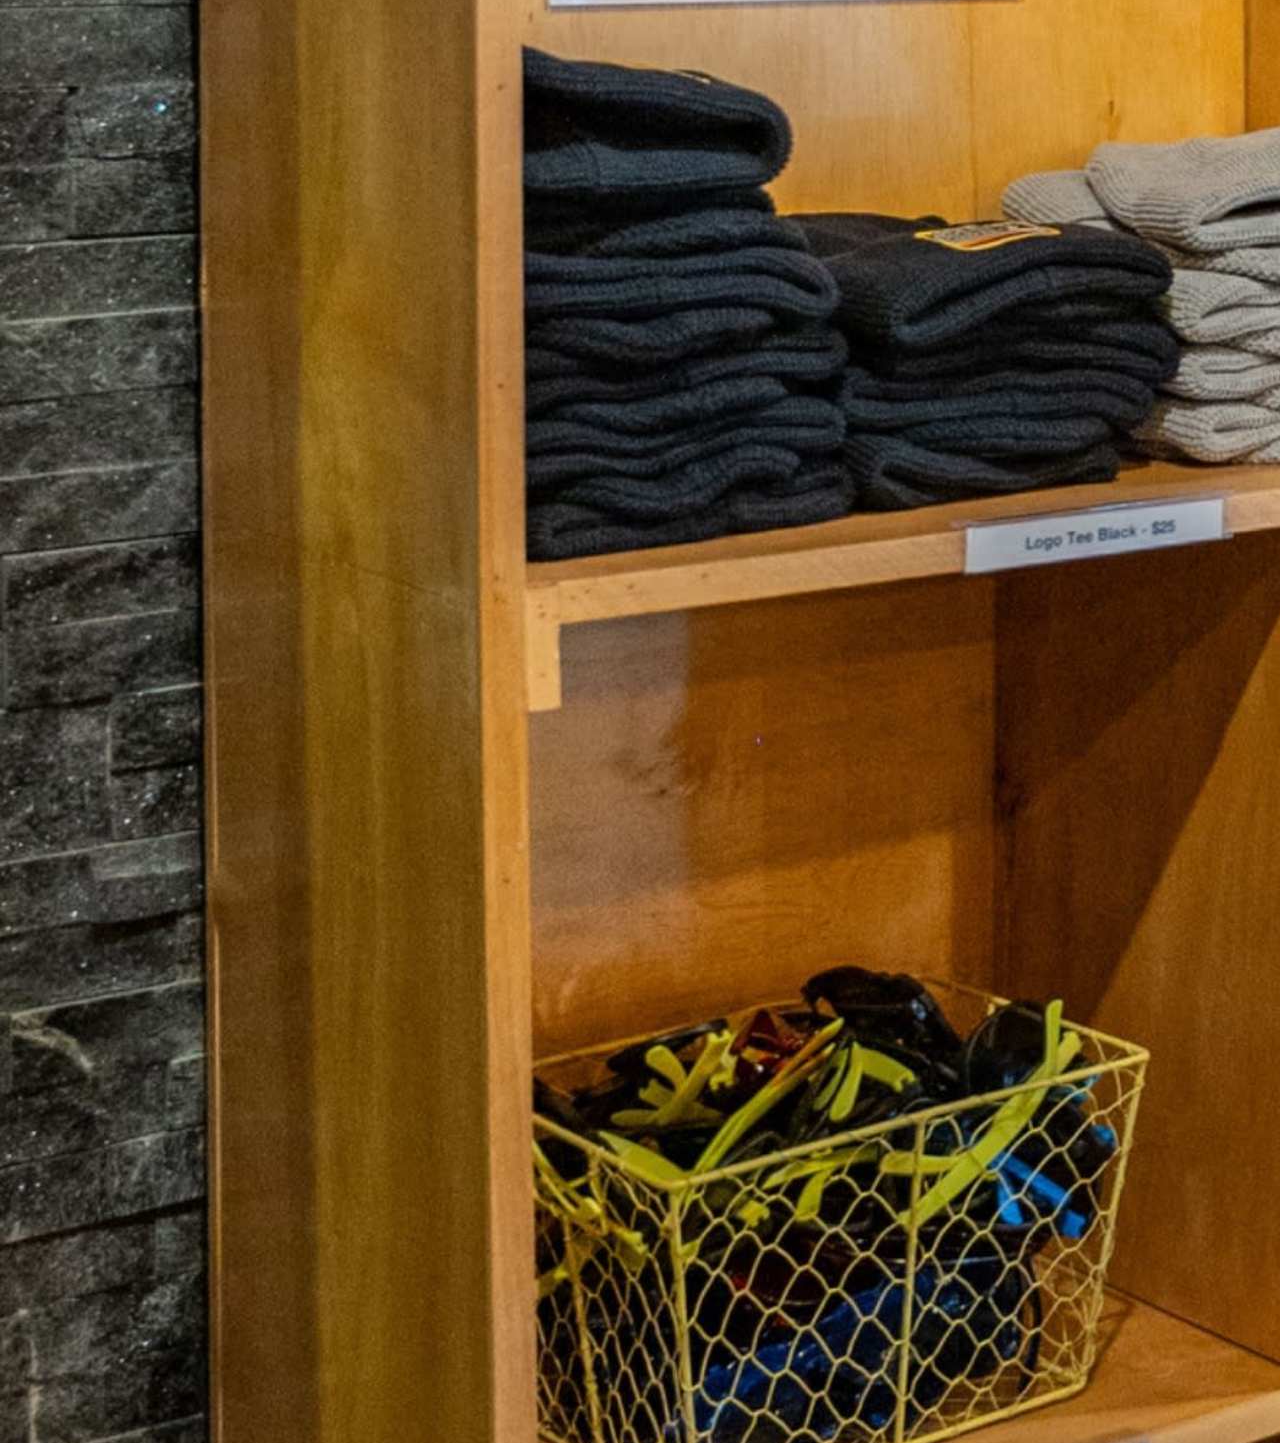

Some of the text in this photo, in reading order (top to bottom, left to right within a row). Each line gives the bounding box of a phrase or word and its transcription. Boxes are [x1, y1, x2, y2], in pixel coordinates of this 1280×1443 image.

[1024, 519, 1177, 552] Logo Tee Black $25
